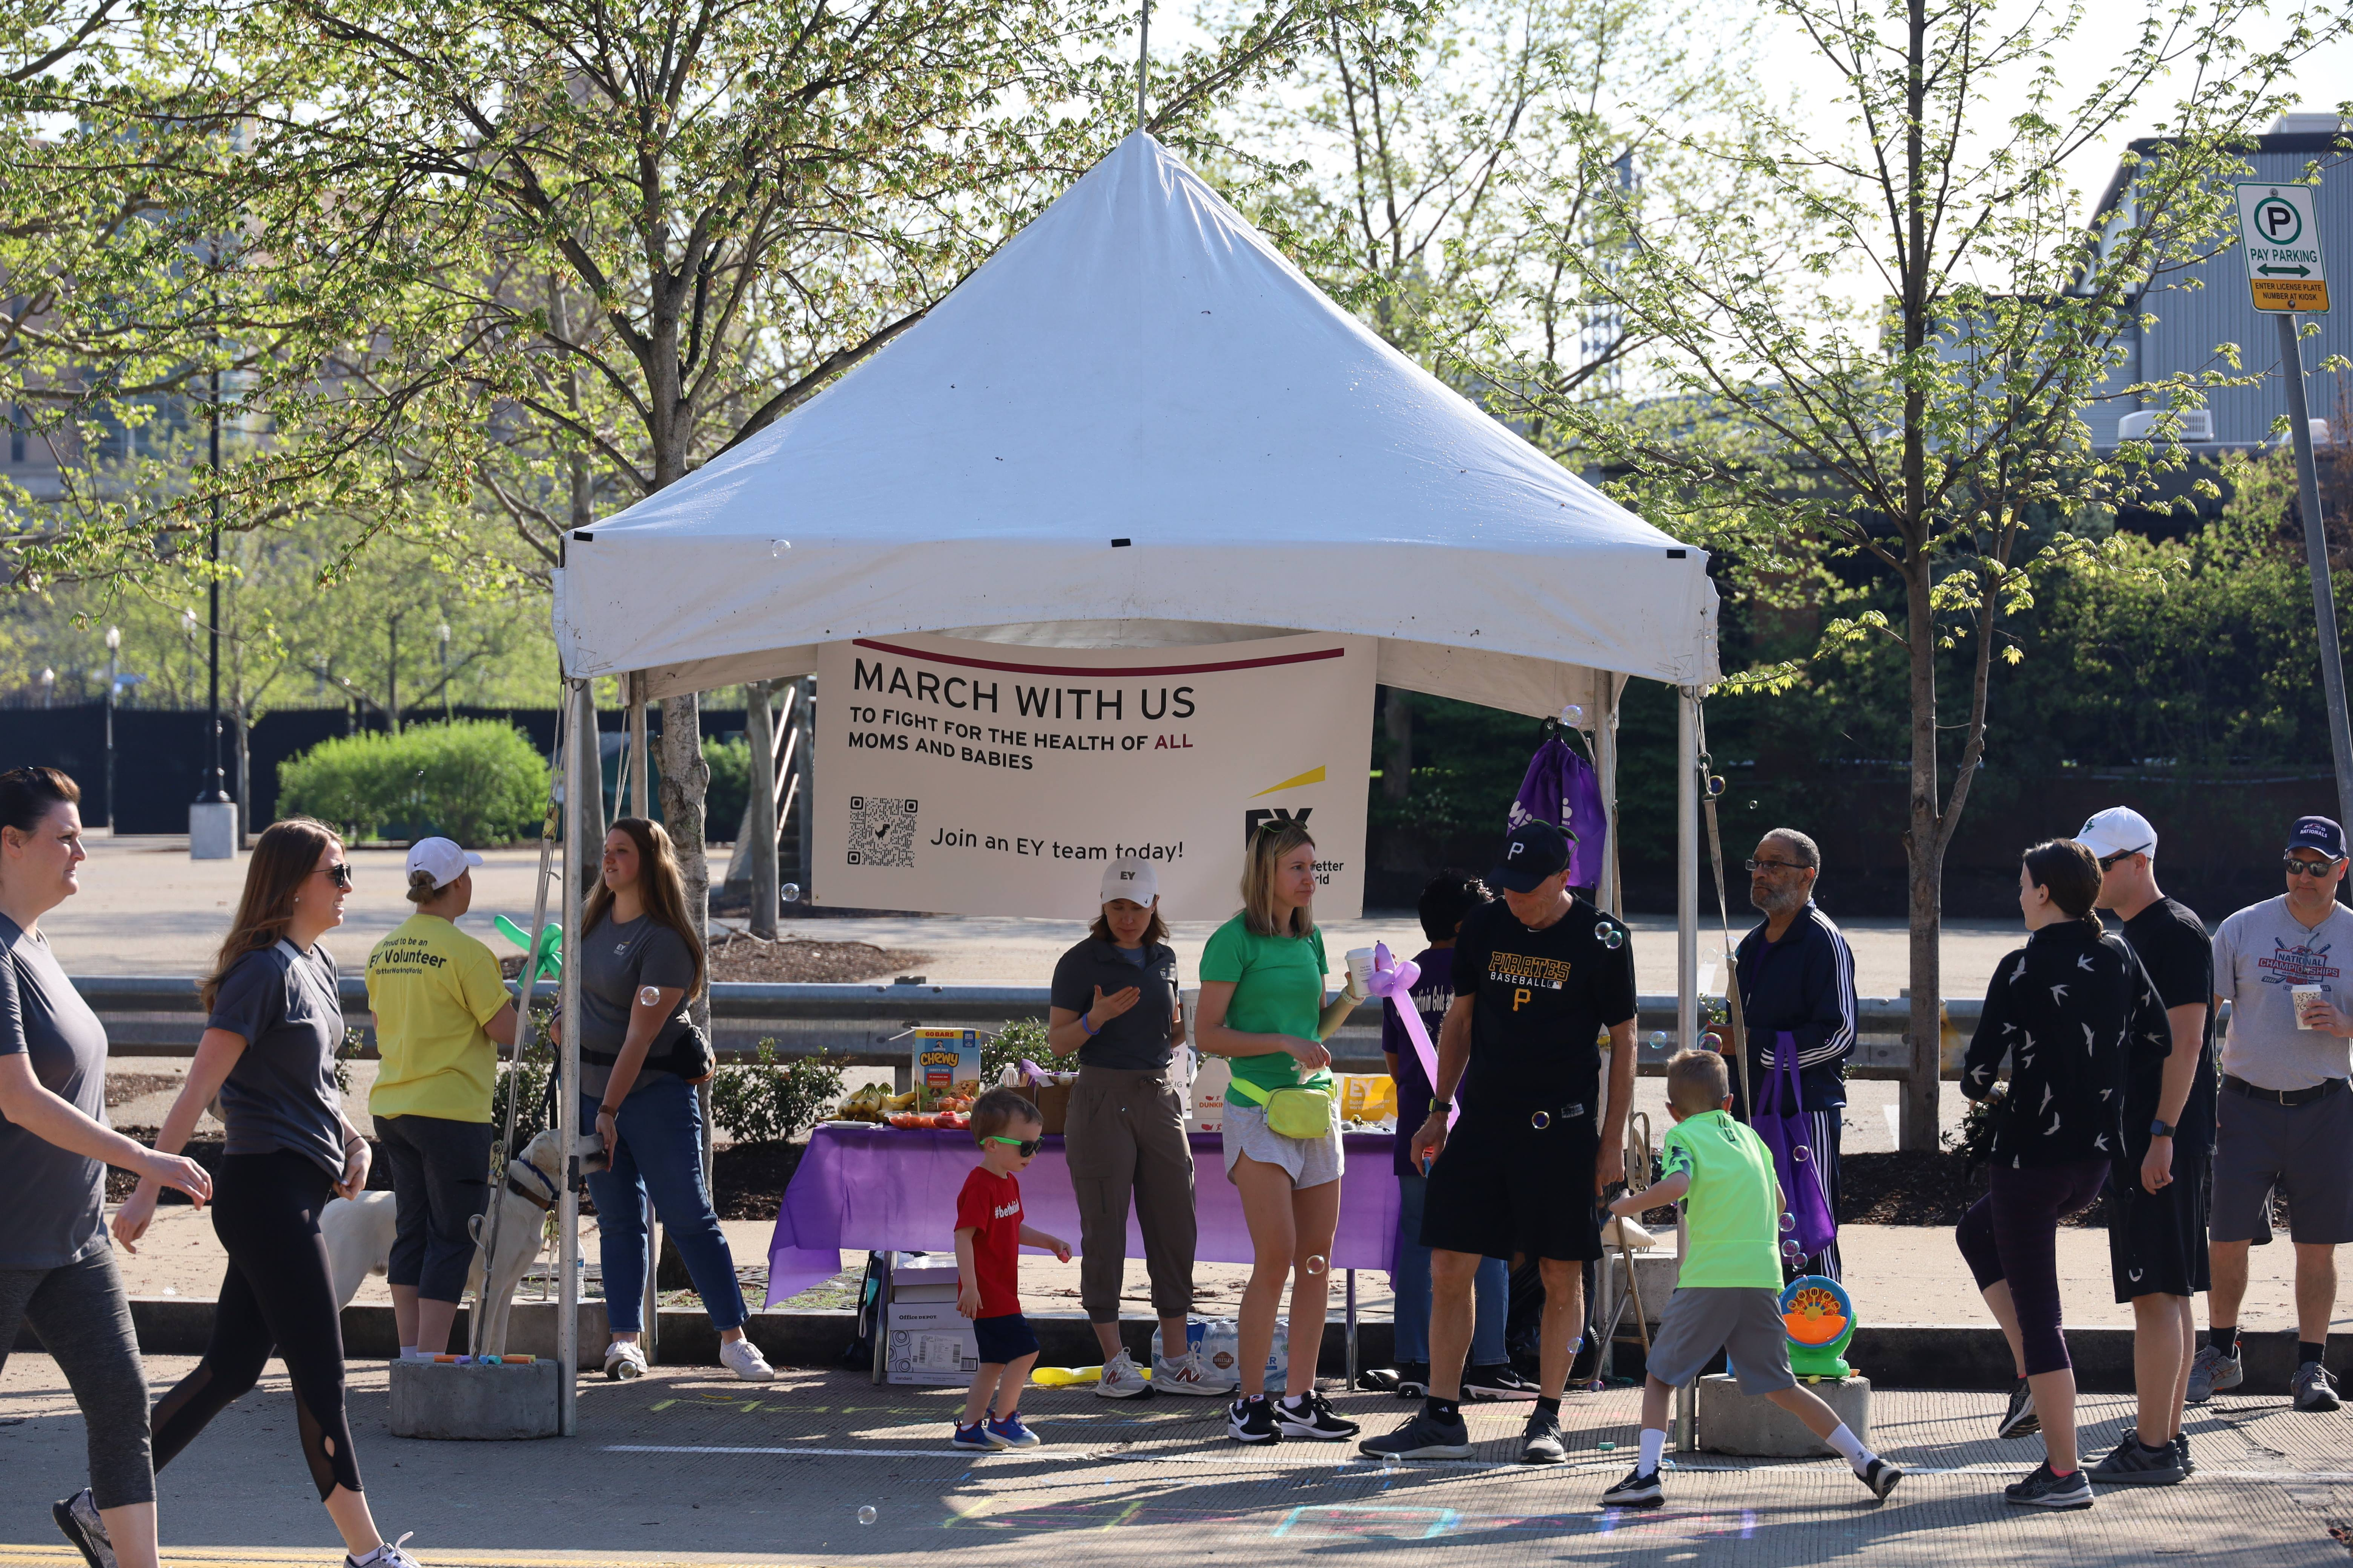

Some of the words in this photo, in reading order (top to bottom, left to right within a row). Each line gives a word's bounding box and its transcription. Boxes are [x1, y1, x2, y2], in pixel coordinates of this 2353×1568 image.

[2267, 207, 2290, 236] P
[2250, 248, 2269, 261] PAY
[2272, 249, 2317, 262] PARKING
[854, 658, 997, 713] MARCH
[1015, 685, 1122, 720] WITH
[1141, 686, 1195, 720] US
[850, 707, 876, 723] TO
[883, 709, 938, 731] FIGHT
[944, 721, 981, 741] FOR
[988, 728, 1027, 746] THE
[1034, 733, 1114, 750] HEALTH
[1121, 736, 1148, 750] OF
[1154, 733, 1194, 750] ALL
[849, 731, 909, 750] MOMS
[915, 738, 955, 758] AND
[961, 747, 1033, 770] BABIES
[2300, 829, 2327, 838] NATIONALS
[930, 828, 977, 847] Join
[985, 836, 1009, 852] an
[1017, 838, 1045, 856] EY
[1052, 841, 1107, 860] team
[1115, 841, 1183, 862] today!
[1507, 842, 1525, 860] P
[1314, 861, 1344, 871] etter
[1120, 871, 1136, 880] EY
[1315, 874, 1330, 885] rld
[382, 937, 399, 948] Proud
[408, 937, 416, 945] be
[369, 951, 383, 969] EY
[385, 948, 447, 968] Volunteer
[1488, 951, 1571, 981] PIRATES
[2260, 959, 2338, 976] CHAMPIONSHIPS
[1490, 971, 1546, 987] BASEBALL
[1513, 988, 1531, 1012] P
[1350, 1079, 1376, 1097] EY
